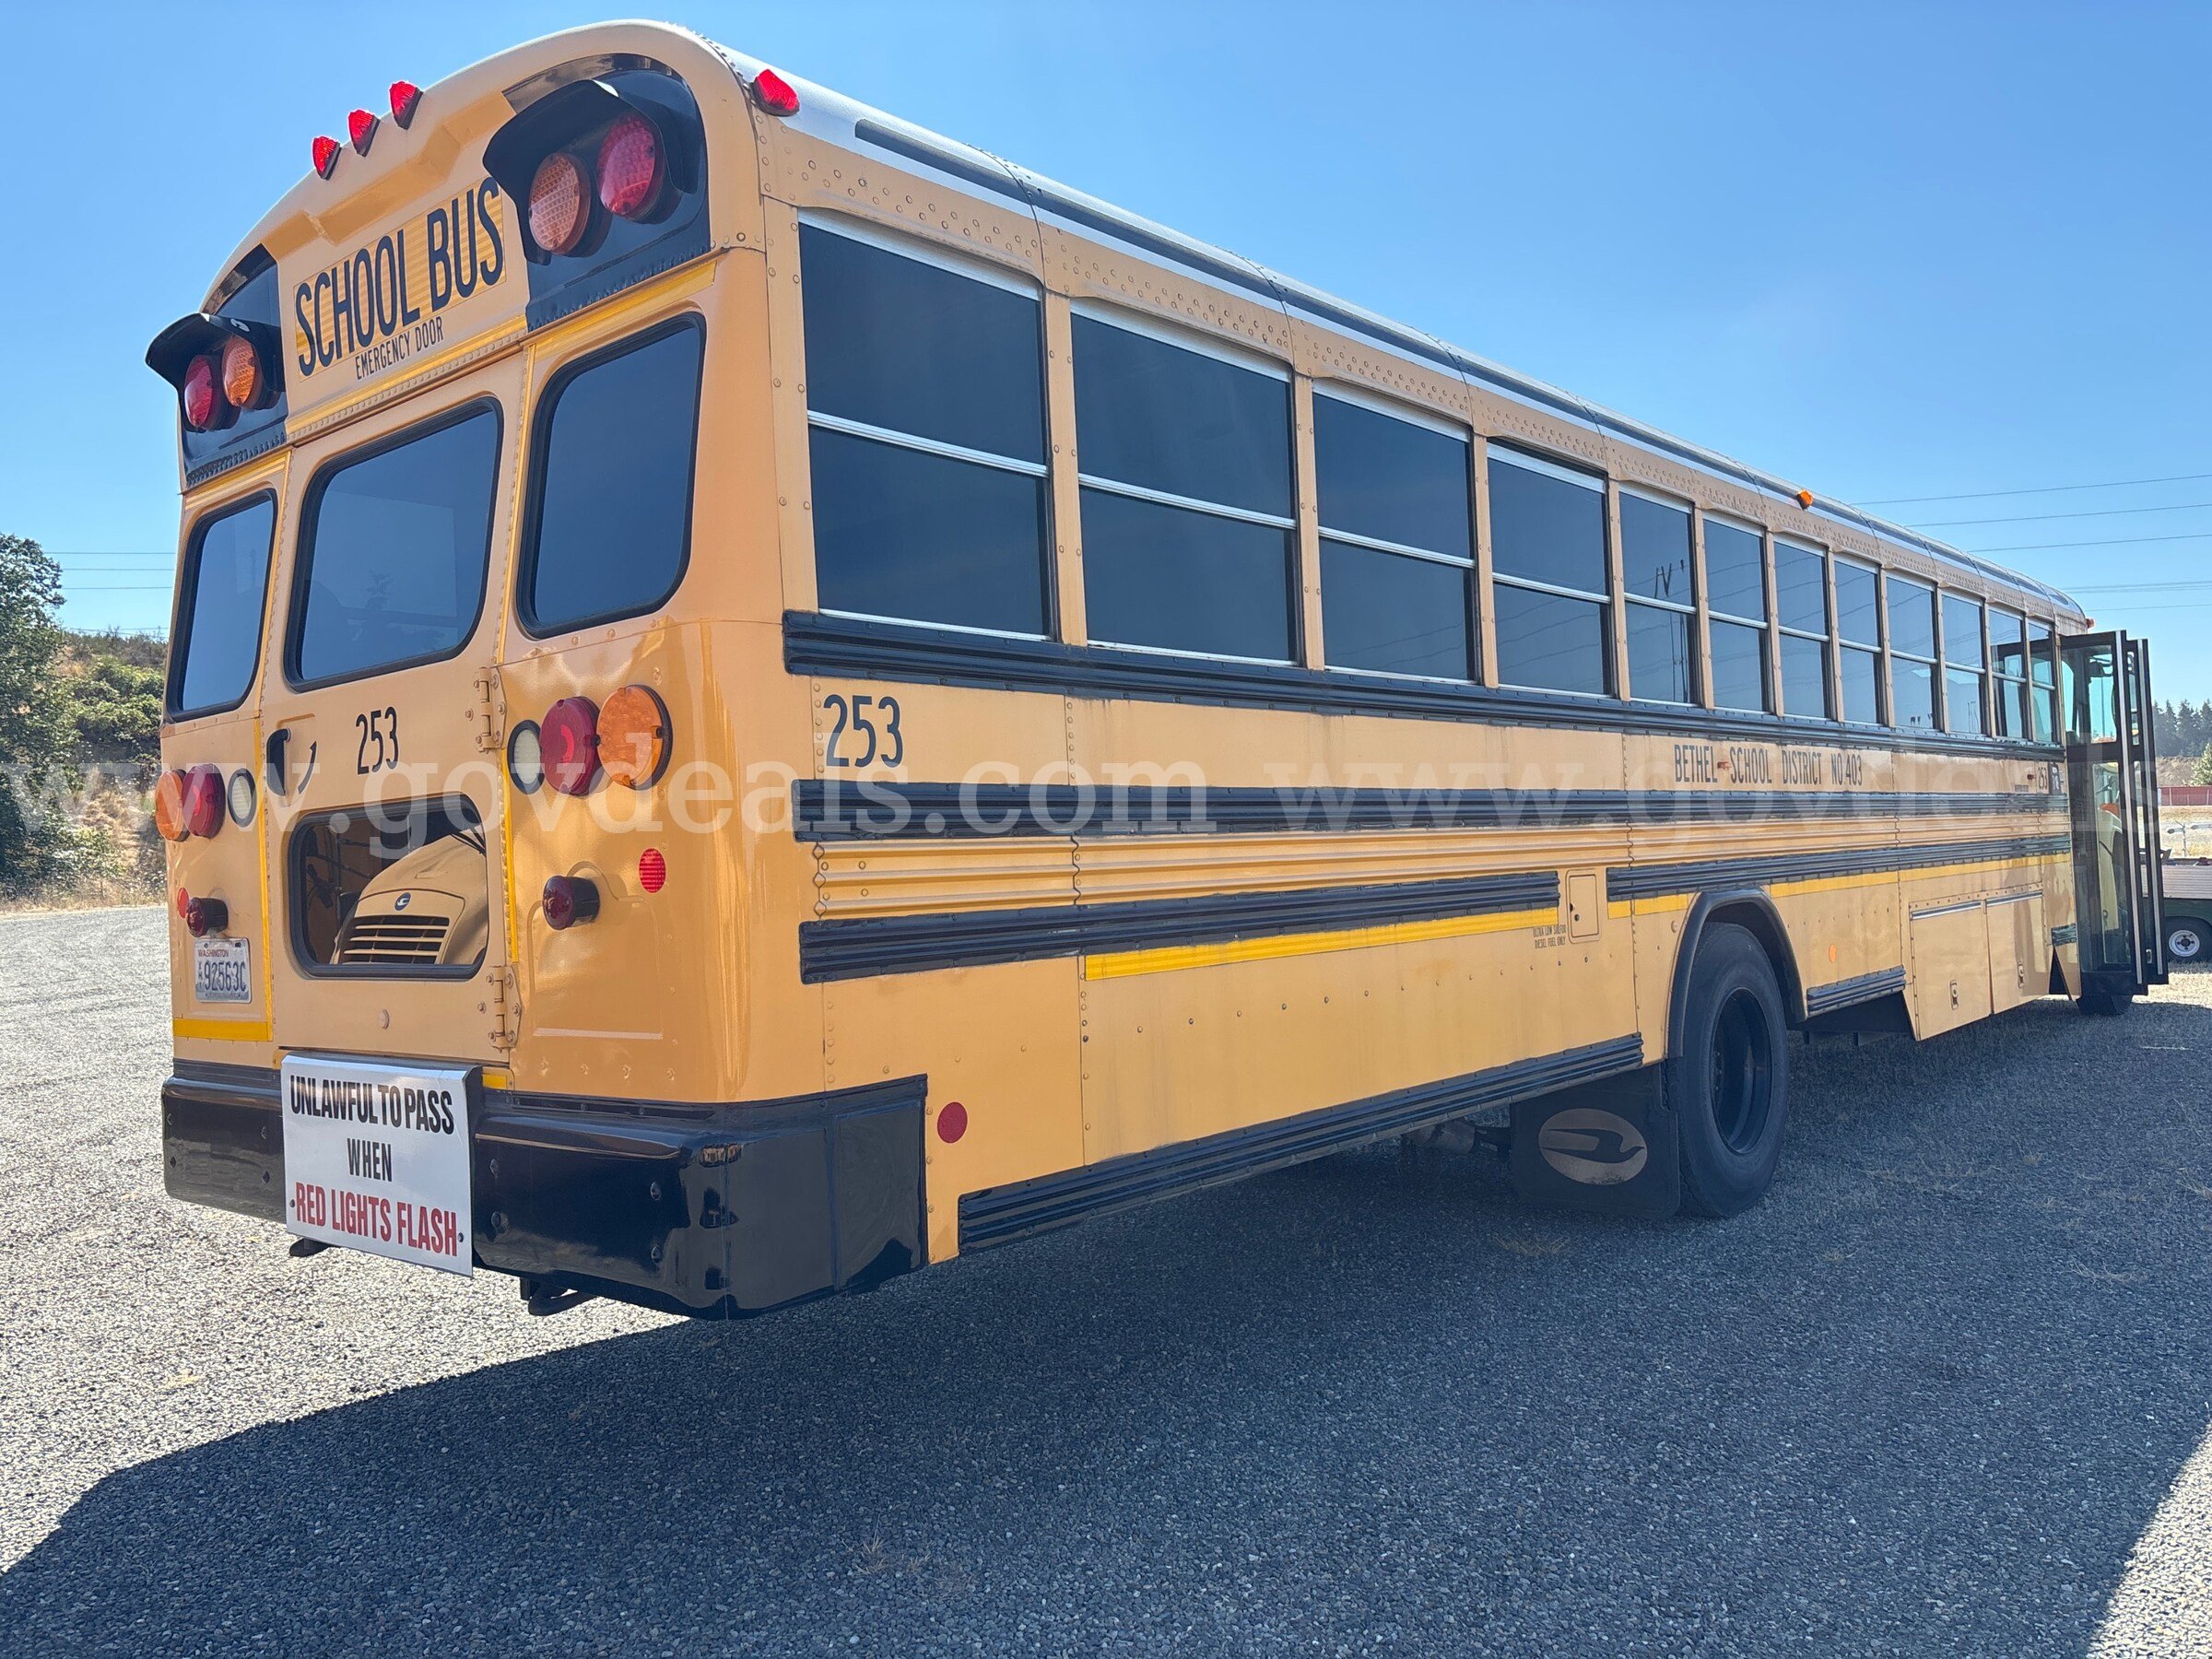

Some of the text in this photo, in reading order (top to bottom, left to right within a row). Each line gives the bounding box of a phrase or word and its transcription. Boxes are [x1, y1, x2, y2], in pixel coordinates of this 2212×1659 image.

[295, 176, 503, 376] SCHOOL BUS
[355, 316, 444, 381] EMERGENCY DOOR
[355, 706, 399, 775] 253
[822, 694, 904, 768] 253
[1674, 744, 1718, 783] BETHEL
[1729, 747, 1772, 784] SCHOOL
[1781, 749, 1822, 785] DISTRICT
[204, 960, 246, 992] 92563C
[290, 1075, 454, 1135] UNLAWFUL TO PASS
[347, 1137, 393, 1182] WHEN
[296, 1182, 457, 1256] RED LIGHTS FLASH
